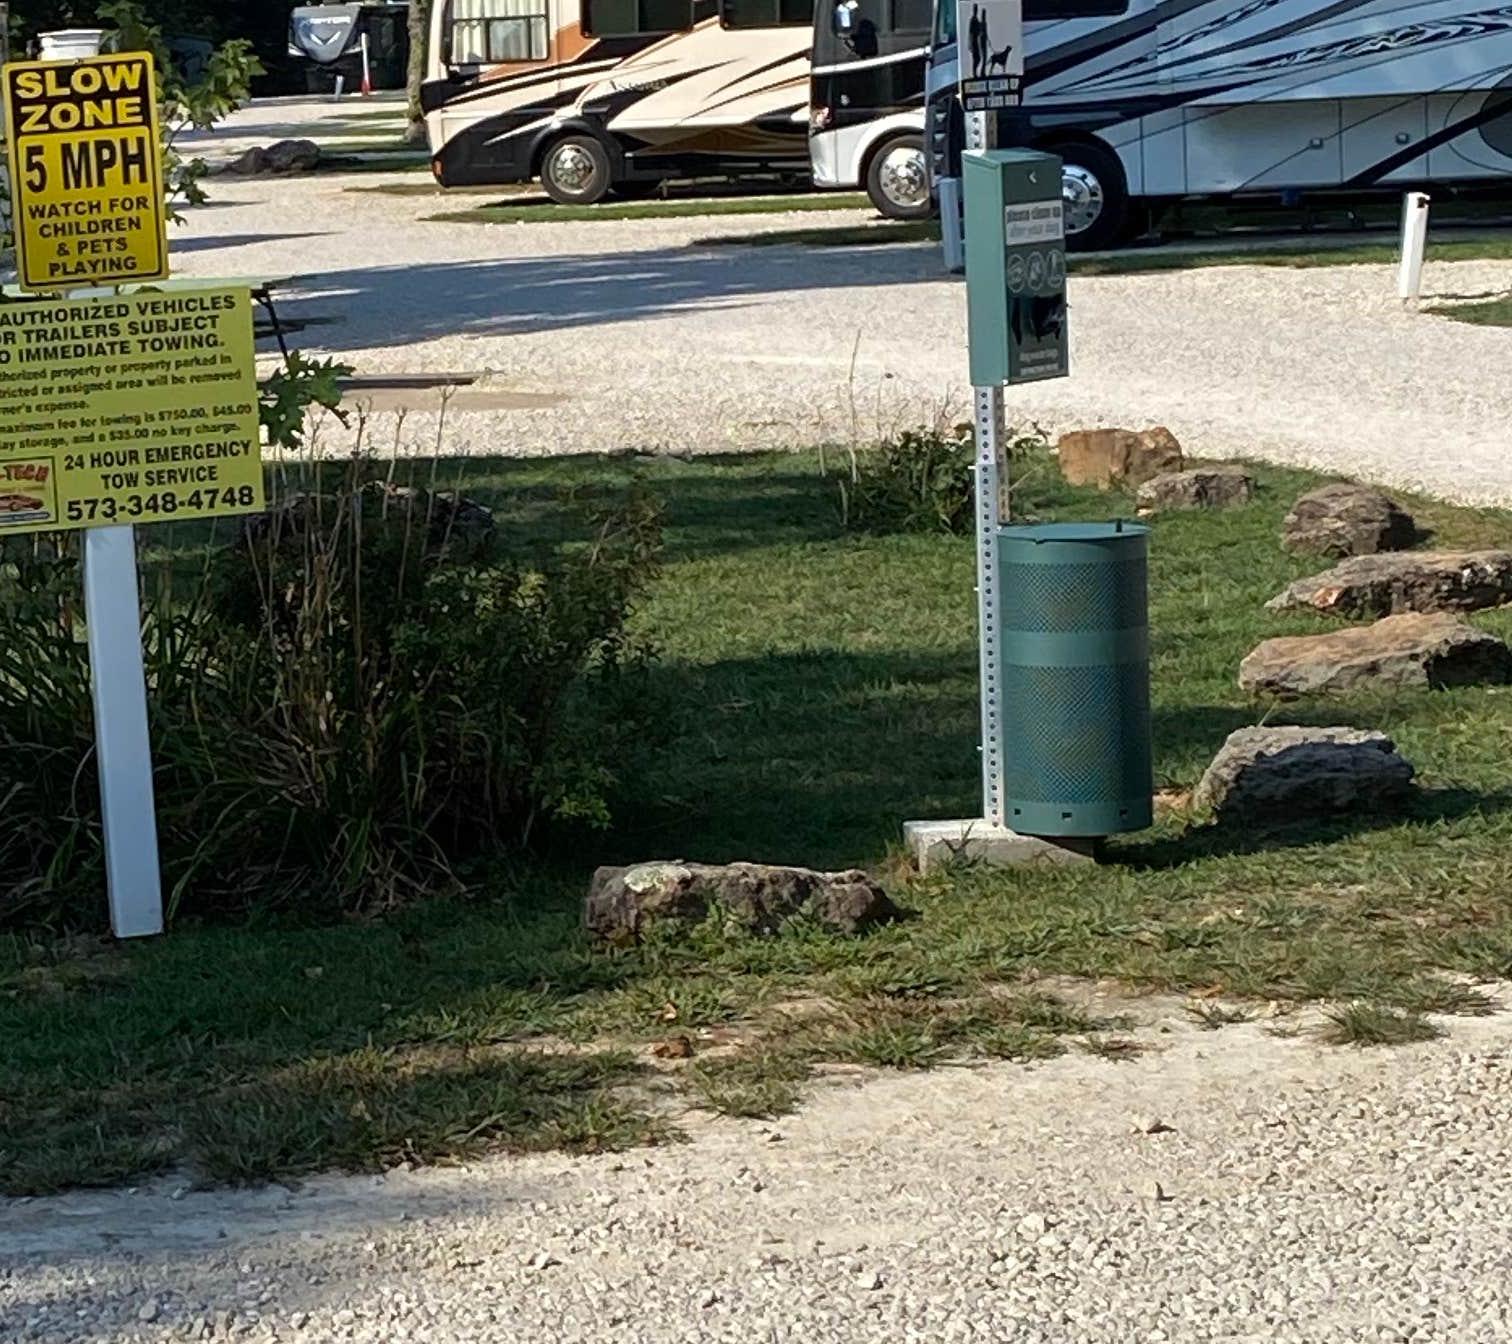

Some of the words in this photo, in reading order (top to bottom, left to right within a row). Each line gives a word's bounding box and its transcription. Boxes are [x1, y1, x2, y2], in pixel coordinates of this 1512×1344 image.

[16, 63, 142, 99] SLOW
[20, 97, 143, 132] ZONE
[26, 145, 47, 193] 5
[61, 136, 148, 190] MPH
[28, 199, 101, 219] WATCH
[110, 195, 150, 212] FOR
[39, 216, 141, 238] CHILDREN
[56, 241, 70, 257] &
[77, 237, 128, 255] PETS
[48, 256, 138, 276] PLAYING
[136, 295, 236, 316] VEHICLES
[22, 322, 121, 343] TRAILERS
[128, 314, 220, 335] SUBJECT
[18, 340, 131, 362] IMMEDIATE
[136, 334, 225, 353] TOWING.
[50, 365, 101, 380] property
[105, 364, 117, 374] or
[121, 358, 171, 374] property
[175, 354, 217, 370] parked
[220, 354, 232, 364] in
[42, 386, 54, 395] or
[58, 380, 113, 395] assigned
[115, 378, 143, 390] area
[146, 375, 168, 386] will
[172, 374, 186, 384] be
[190, 368, 242, 384] removed
[35, 400, 90, 414] expense.
[58, 418, 77, 429] fee
[80, 416, 97, 427] for
[100, 414, 141, 425] towing
[144, 412, 156, 422] is
[19, 437, 69, 448] storage,
[73, 432, 95, 444] and
[98, 433, 106, 442] a
[152, 428, 167, 438] no
[171, 426, 191, 437] key
[195, 422, 240, 434] charge.
[64, 455, 85, 470] 24
[90, 450, 141, 468] HOUR
[145, 440, 252, 464] EMERGENCY
[100, 472, 139, 490] TOW
[144, 466, 218, 486] SERVICE
[67, 485, 254, 521] 573-348-4748
